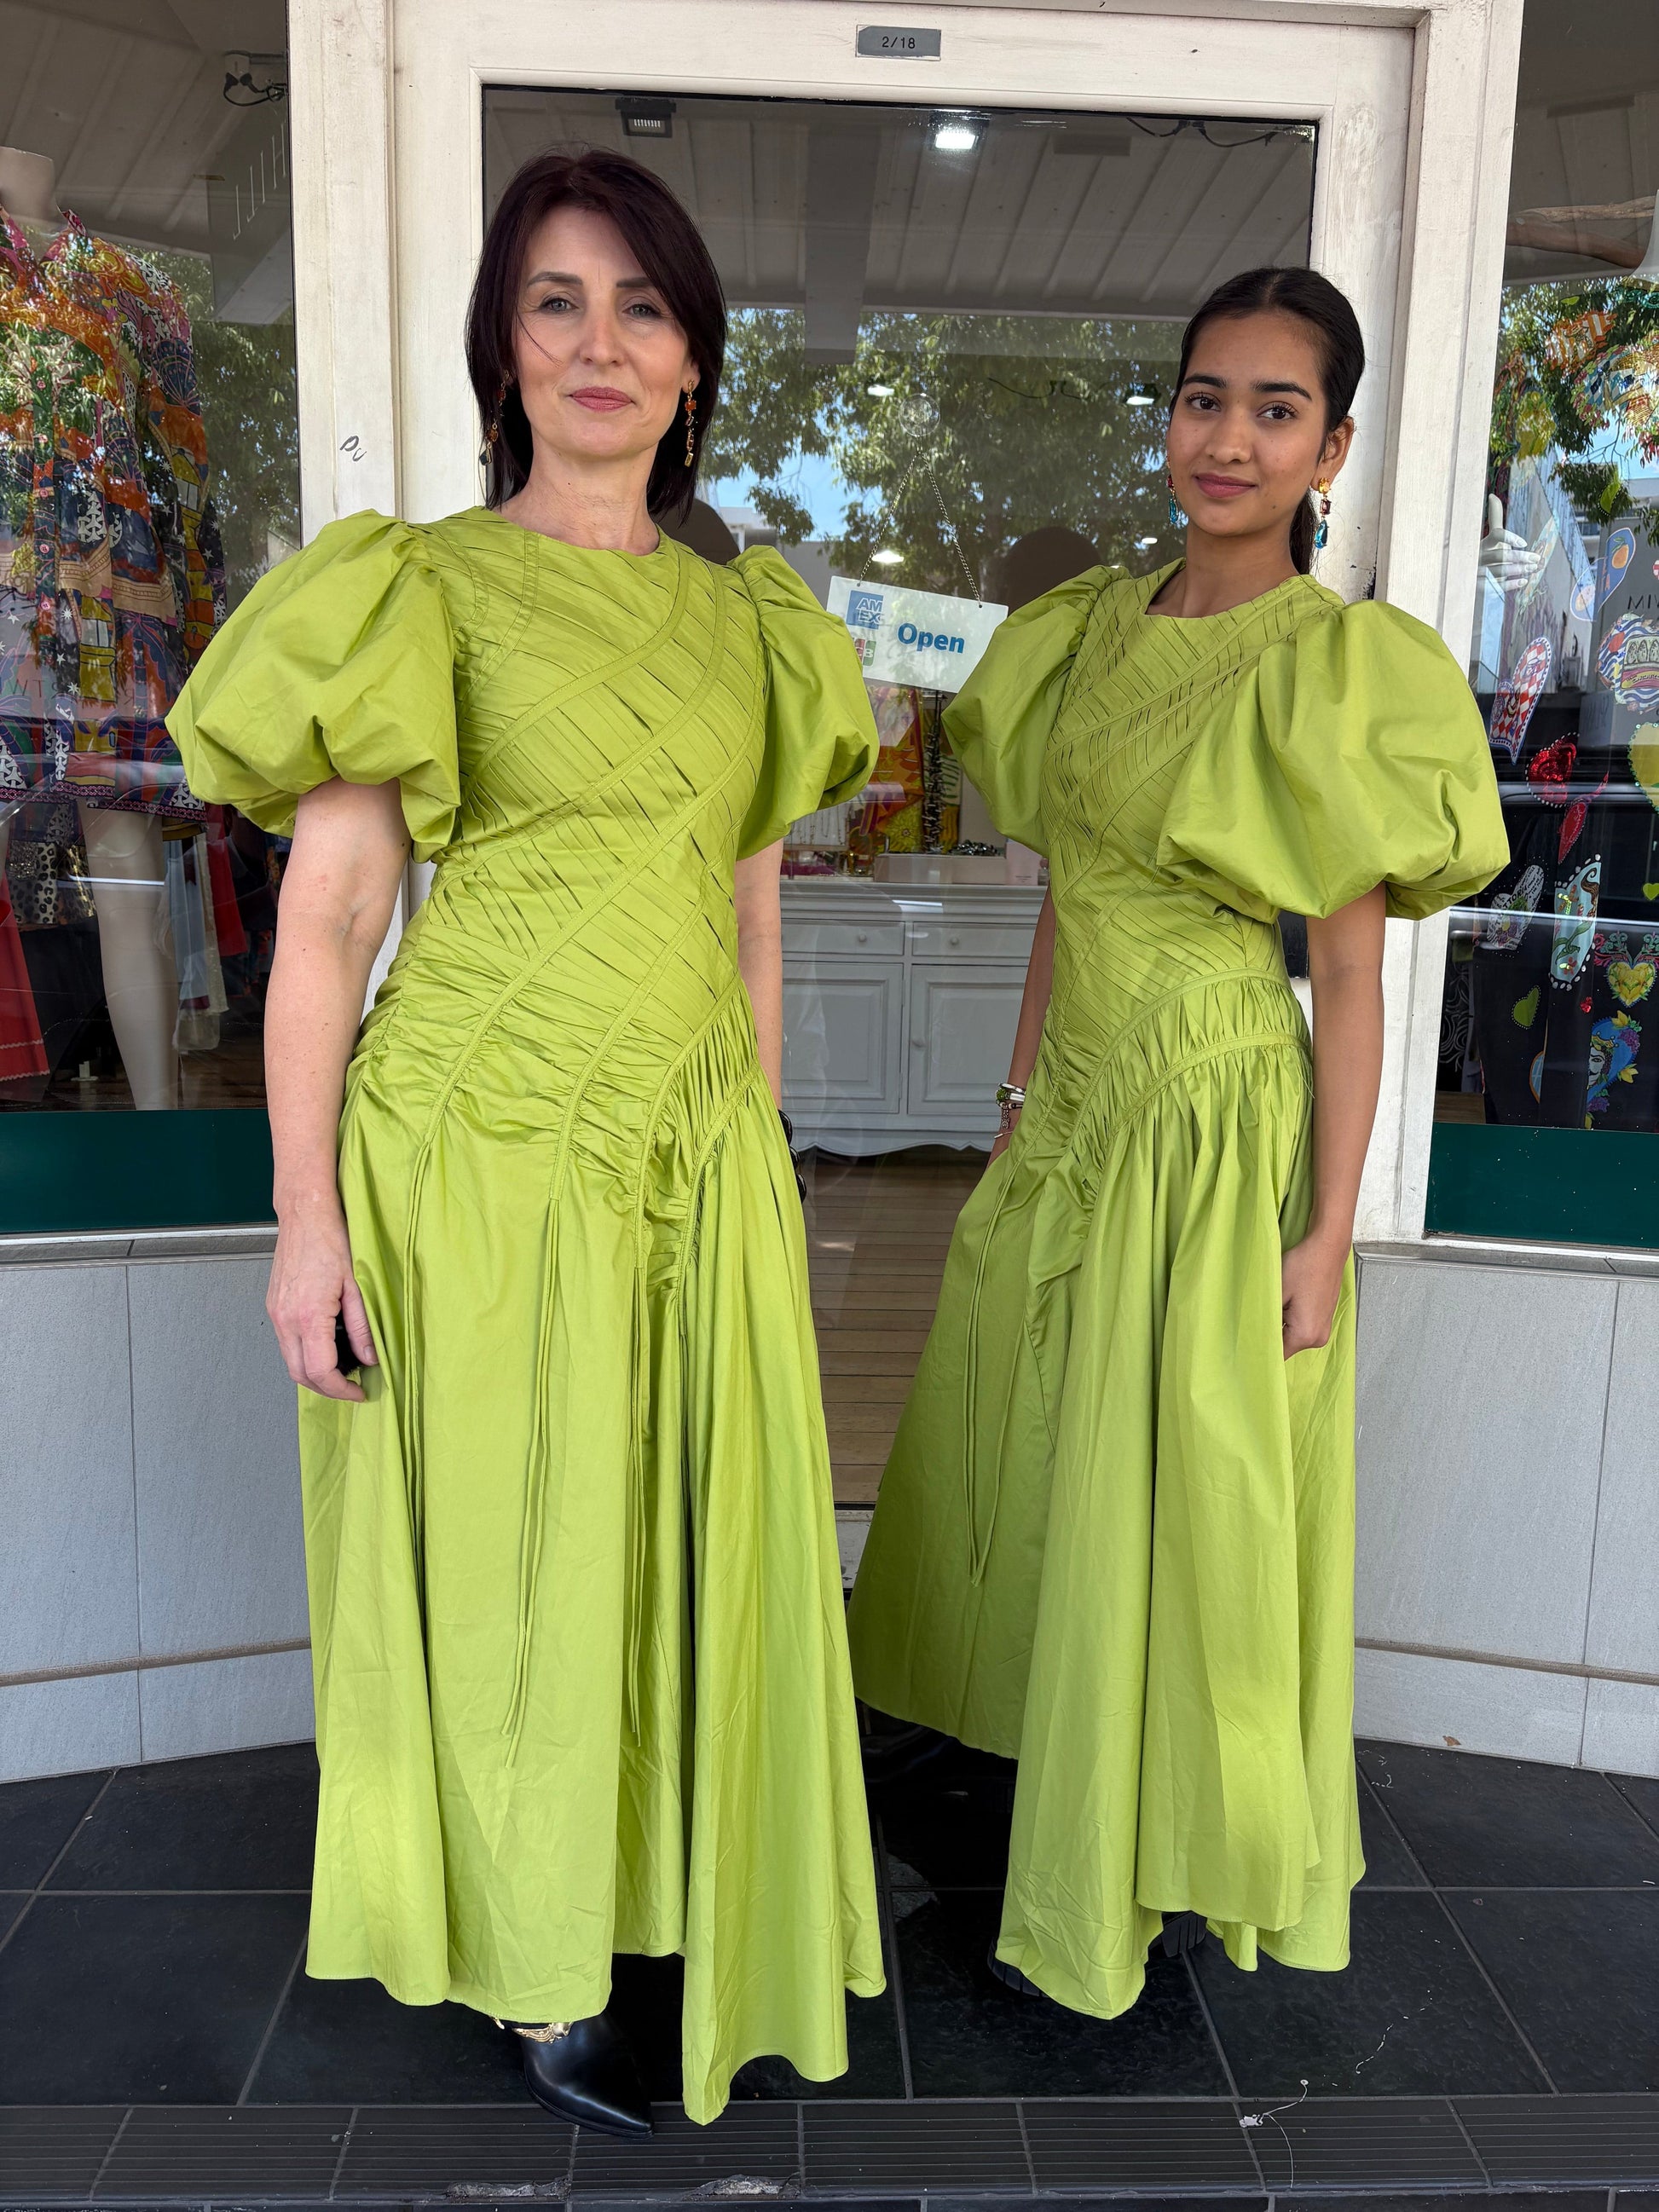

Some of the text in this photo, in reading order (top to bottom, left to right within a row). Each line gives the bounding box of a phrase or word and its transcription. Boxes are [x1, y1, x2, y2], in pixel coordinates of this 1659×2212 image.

[882, 36, 916, 49] 2/18
[856, 598, 882, 612] AM
[898, 622, 965, 654] Open
[855, 645, 874, 658] CB
